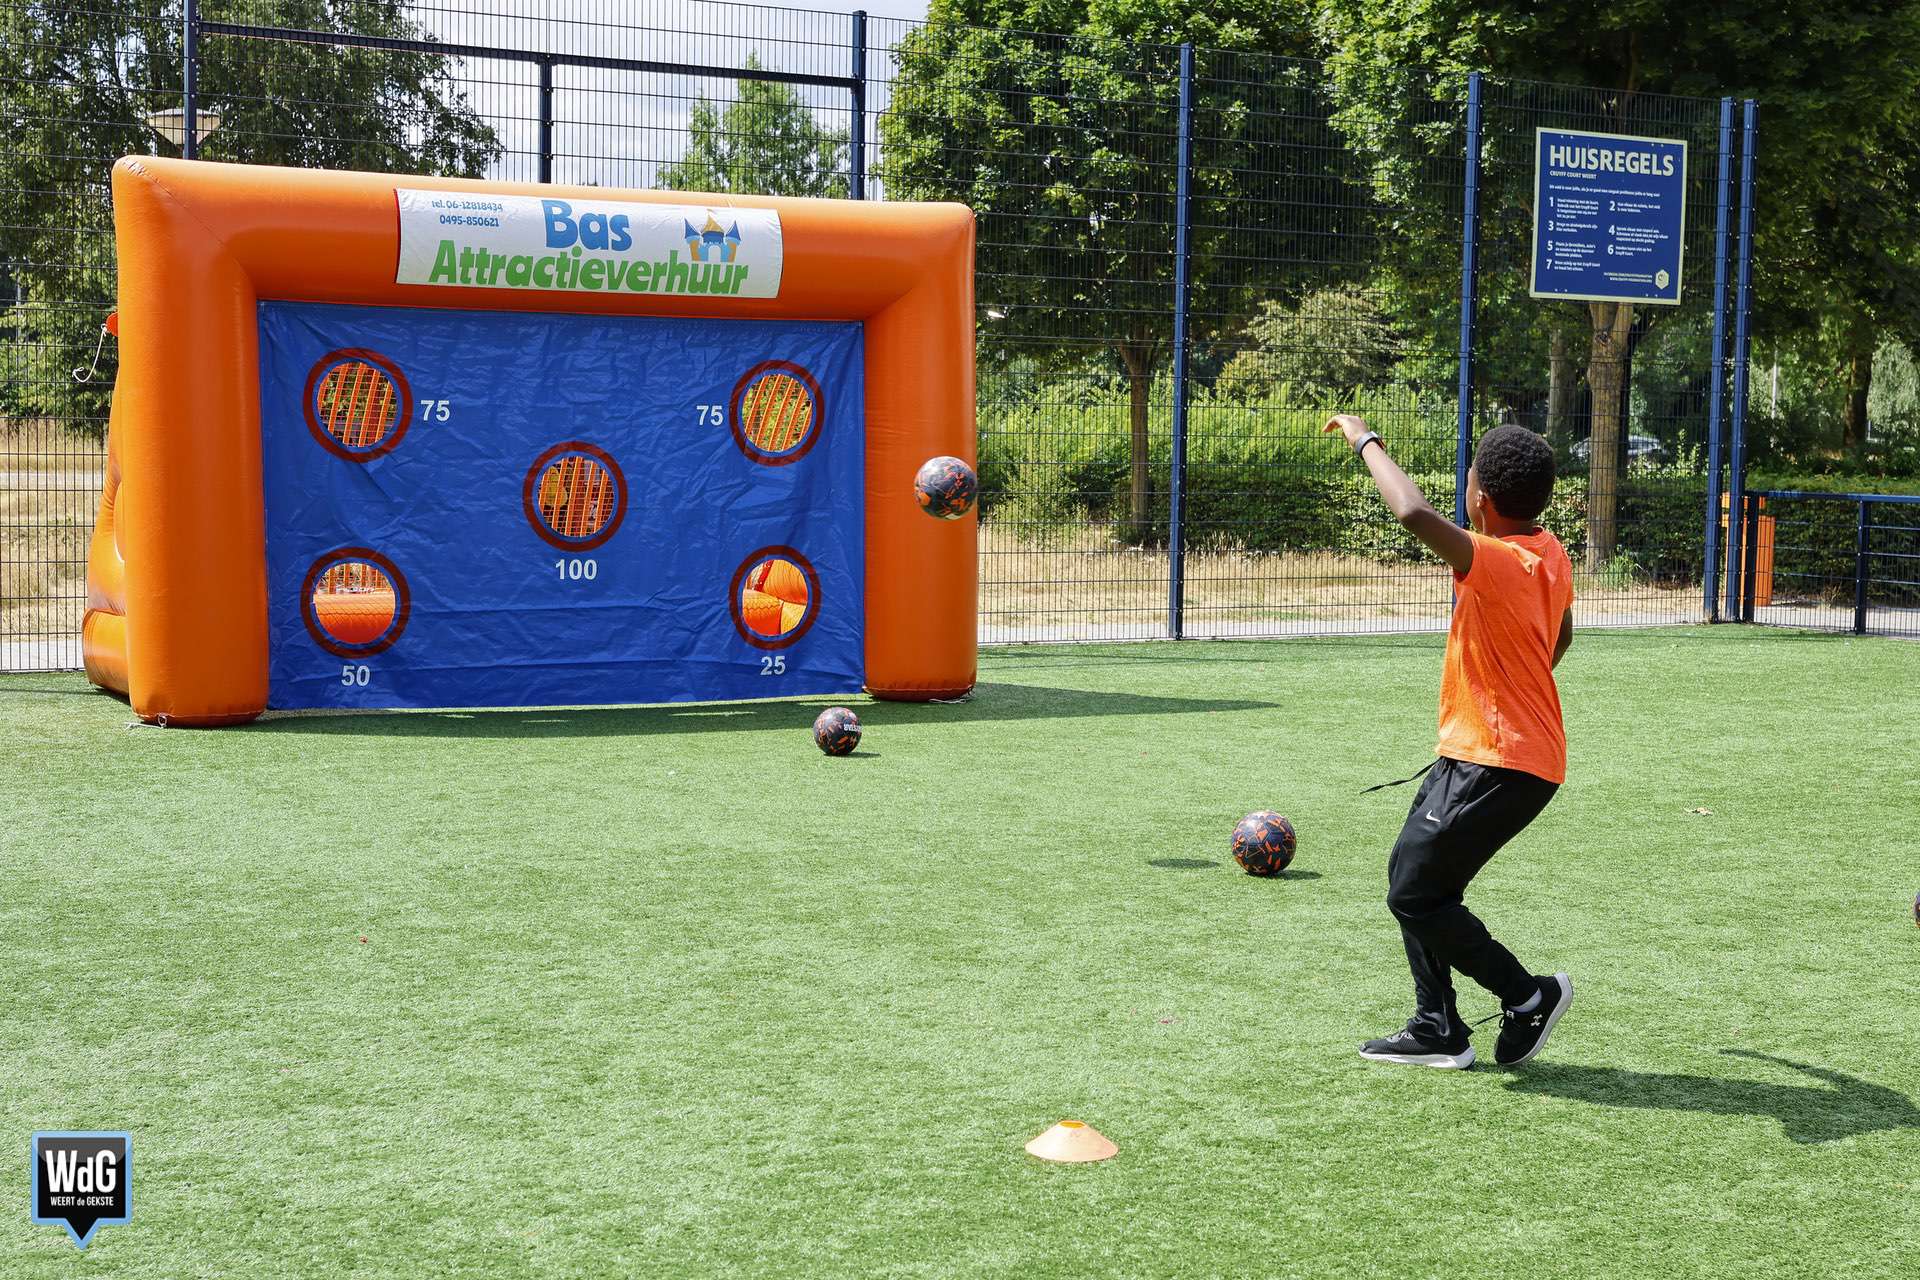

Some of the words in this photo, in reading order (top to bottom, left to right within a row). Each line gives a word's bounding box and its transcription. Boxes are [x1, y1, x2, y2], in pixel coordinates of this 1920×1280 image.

[1549, 144, 1674, 177] HUISREGELS
[446, 200, 503, 212] 06-12818434
[1549, 197, 1554, 207] 1
[1609, 200, 1616, 211] 2
[440, 215, 500, 227] 0495-850621
[541, 200, 633, 251] Bas
[1548, 220, 1554, 231] 3
[1608, 225, 1615, 236] 4
[1547, 240, 1553, 251] 5
[1607, 244, 1614, 255] 6
[428, 239, 749, 295] Attractieverhuur
[1546, 259, 1552, 270] 7
[421, 400, 451, 423] 75
[696, 405, 724, 426] 75
[555, 559, 598, 581] 100
[760, 655, 787, 676] 25
[341, 665, 371, 687] 50
